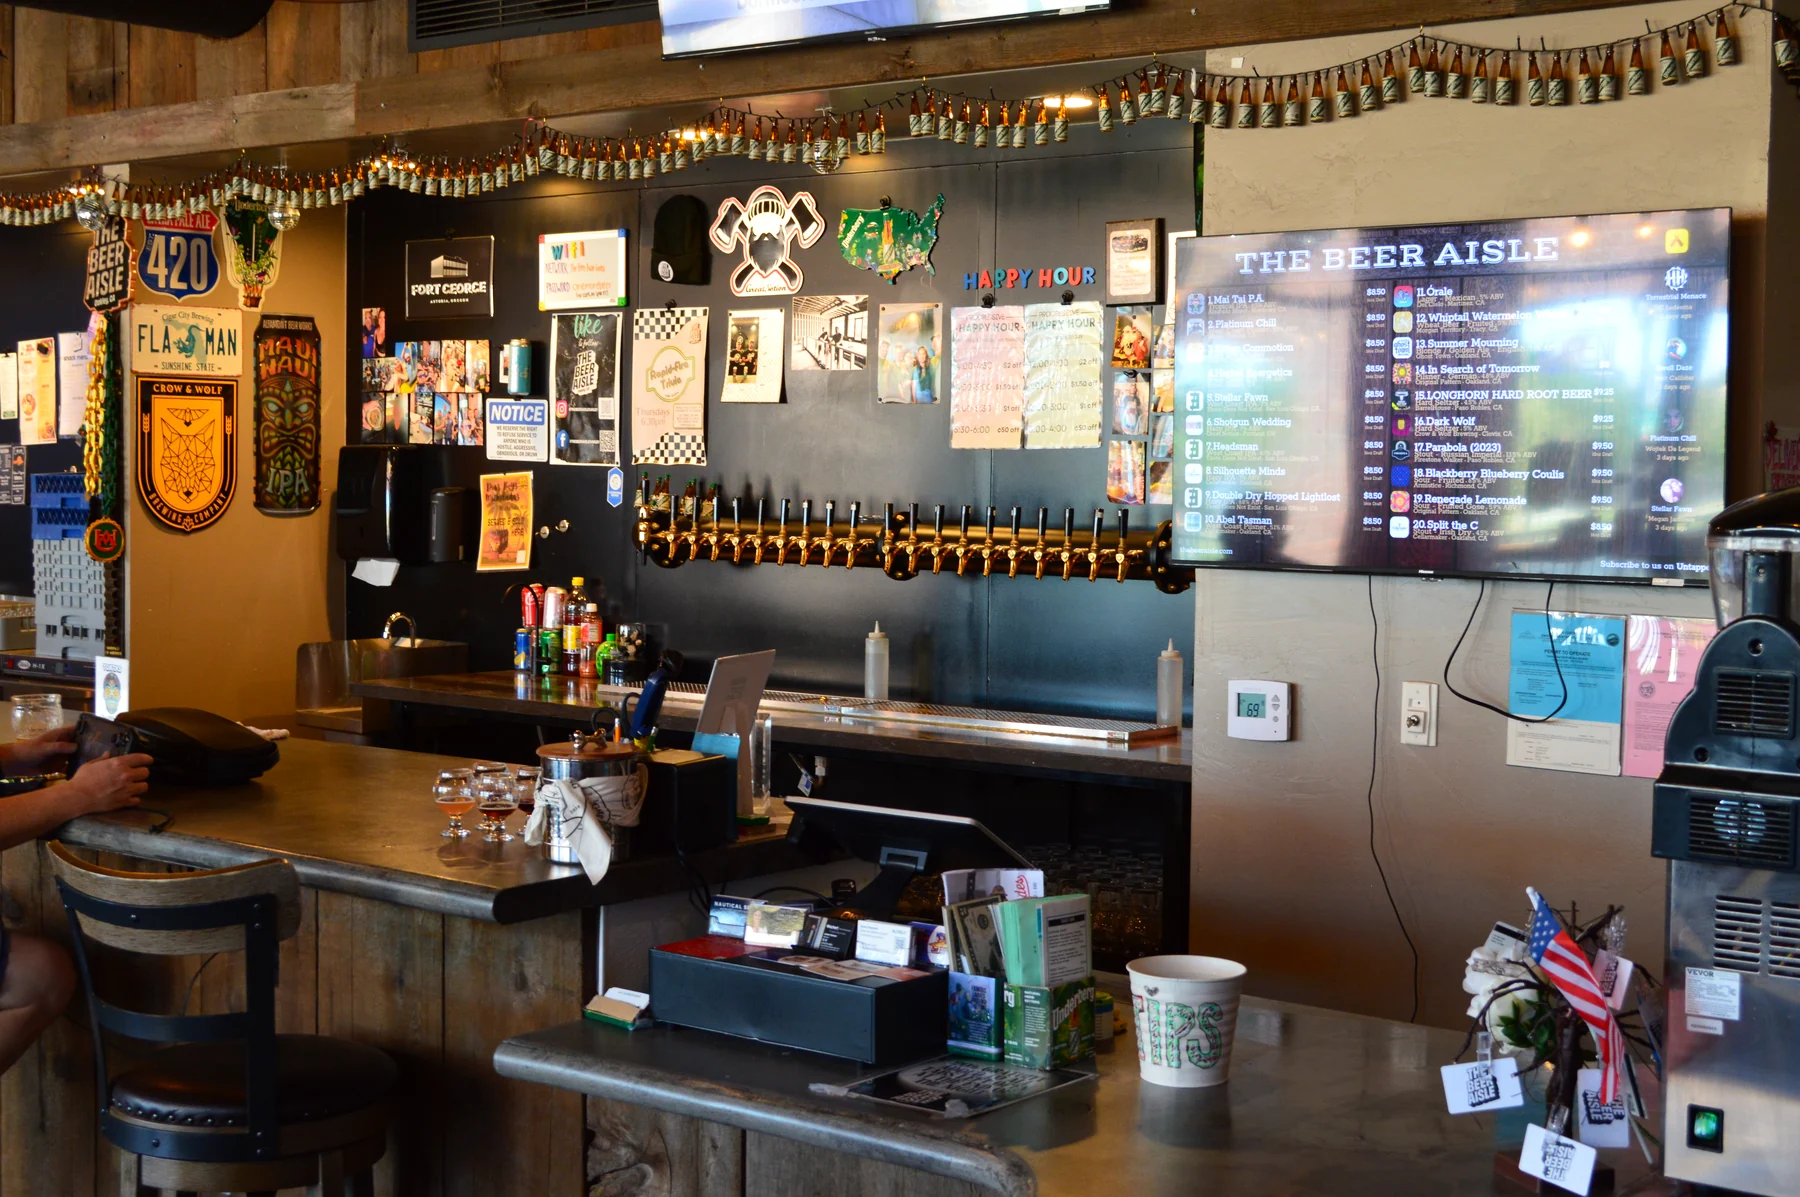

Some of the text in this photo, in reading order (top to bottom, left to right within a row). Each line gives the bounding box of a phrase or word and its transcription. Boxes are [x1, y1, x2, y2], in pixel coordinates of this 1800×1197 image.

[195, 213, 211, 229] ALE
[841, 215, 865, 249] Underberg
[89, 241, 125, 274] BEER
[1235, 236, 1559, 275] THE BEER AISLE
[146, 234, 208, 291] 420
[86, 265, 124, 300] AISLE
[963, 268, 1033, 290] HAPPY
[1038, 266, 1096, 288] HOUR
[410, 281, 487, 296] FORT GEORGE
[1366, 287, 1386, 297] $8.50
[1231, 294, 1246, 303] Tai
[1645, 293, 1679, 301] Terrestrial
[161, 311, 215, 325] Cigar City Brewing
[1366, 313, 1386, 323] $8.50
[1472, 311, 1532, 321] Watermelon
[573, 314, 604, 339] like
[958, 322, 1021, 333] HAPPY HOUR
[1031, 317, 1096, 330] HAPPY HOUR
[1256, 318, 1276, 328] Chill
[137, 324, 238, 356] FLA MAN
[1365, 338, 1385, 348] $8.50
[1471, 338, 1519, 350] Mourning
[258, 336, 317, 366] MAUI
[1242, 343, 1294, 352] Commotion
[577, 351, 592, 365] THE
[161, 361, 216, 372] SUNSHINE STATE
[259, 355, 316, 385] WAUI
[575, 362, 596, 378] BEER
[1365, 364, 1385, 374] $8.50
[1440, 364, 1474, 374] Search
[1476, 364, 1486, 373] of
[1488, 364, 1540, 374] Tomorrow
[572, 374, 594, 390] AISLE
[659, 375, 683, 391] Trivia
[153, 383, 223, 395] CROW & WOLF
[1365, 390, 1385, 399] $8.50
[1491, 389, 1524, 399] HARD
[1526, 389, 1560, 399] ROOT
[1562, 389, 1592, 399] BEER
[1593, 387, 1614, 396] $9.25
[1244, 393, 1269, 402] Fawn
[490, 404, 544, 422] NOTICE
[636, 407, 670, 418] Thursdays
[1252, 417, 1292, 428] Wedding
[1364, 415, 1384, 425] $8.50
[1452, 416, 1476, 426] Wolf
[1592, 414, 1614, 423] $9.25
[1364, 440, 1384, 450] $8.50
[1470, 442, 1502, 454] (2023)
[1591, 441, 1613, 450] $9.50
[1678, 445, 1701, 453] Legend
[1661, 454, 1676, 462] days
[1258, 467, 1286, 477] Minds
[1363, 466, 1383, 475] $8.50
[1480, 469, 1529, 481] Blueberry
[1532, 469, 1565, 479] Coulis
[1591, 468, 1613, 477] $9.50
[265, 467, 310, 497] IPA
[1245, 491, 1262, 503] Dry
[1264, 491, 1299, 503] Hopped
[1301, 491, 1341, 503] Lightlost
[1363, 491, 1383, 501] $8.50
[1475, 495, 1527, 505] Lemonade
[1591, 495, 1613, 504] $9.50
[148, 491, 228, 523] BREWING COMPANY
[1238, 516, 1273, 526] Tasman
[1363, 517, 1382, 526] $8.50
[1451, 520, 1468, 530] the
[1469, 520, 1479, 530] C
[1660, 524, 1675, 532] days
[1600, 560, 1640, 569] Subscribe
[1246, 702, 1260, 718] 69
[713, 901, 742, 910] NAUTICAL
[1687, 968, 1714, 977] VEVOR
[1051, 987, 1096, 1031] Underberg
[1131, 994, 1224, 1069] TIPS
[1466, 1063, 1491, 1081] THE
[1467, 1078, 1494, 1093] BEER
[1467, 1086, 1496, 1106] AISLE
[1584, 1089, 1602, 1121] AISLE
[1544, 1154, 1572, 1170] BEER
[1545, 1168, 1567, 1182] THE
